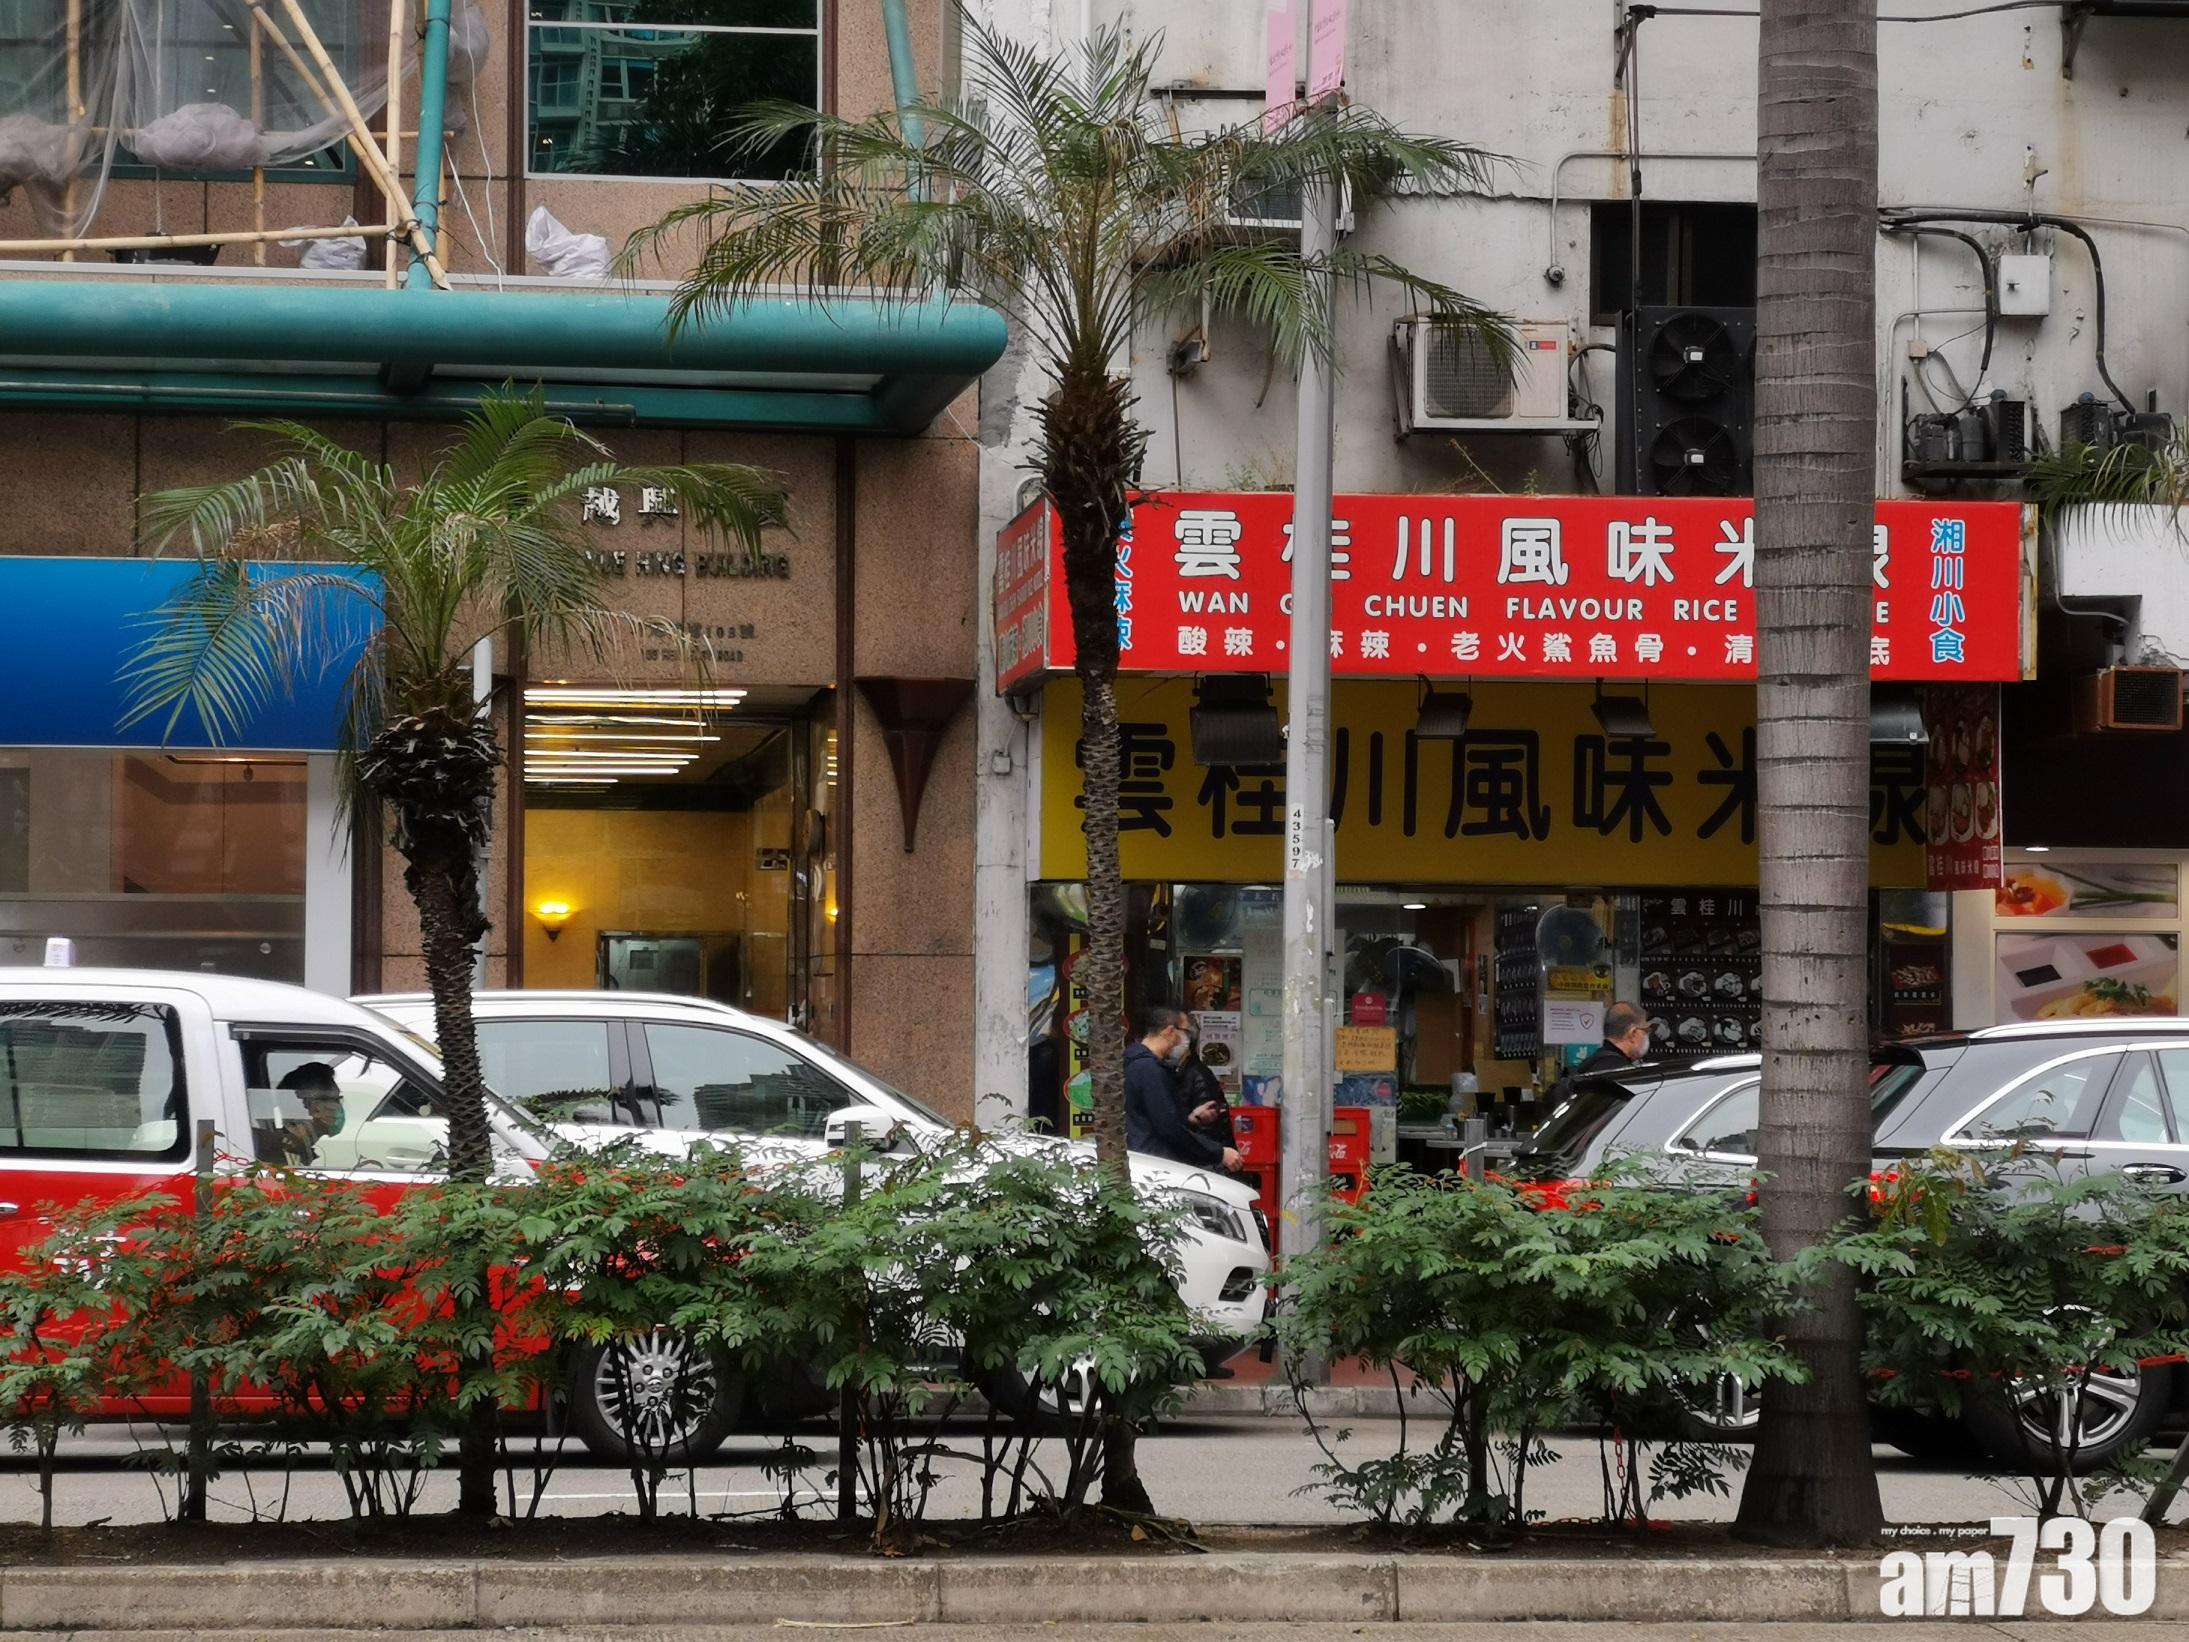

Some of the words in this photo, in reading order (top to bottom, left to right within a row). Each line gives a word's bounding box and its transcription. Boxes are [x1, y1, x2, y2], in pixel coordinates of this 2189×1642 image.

[696, 552, 790, 579] BUILDNG
[1174, 510, 1890, 589] 雲川風味米
[1178, 590, 1249, 614] WAN
[1364, 594, 1468, 618] CHUEN
[1506, 597, 1643, 620] FLAVOUR
[1673, 599, 1737, 621] RICE
[1930, 518, 1966, 663] 湘川小食
[1291, 808, 1302, 869] 43597
[1670, 898, 1760, 917] 雲桂川
